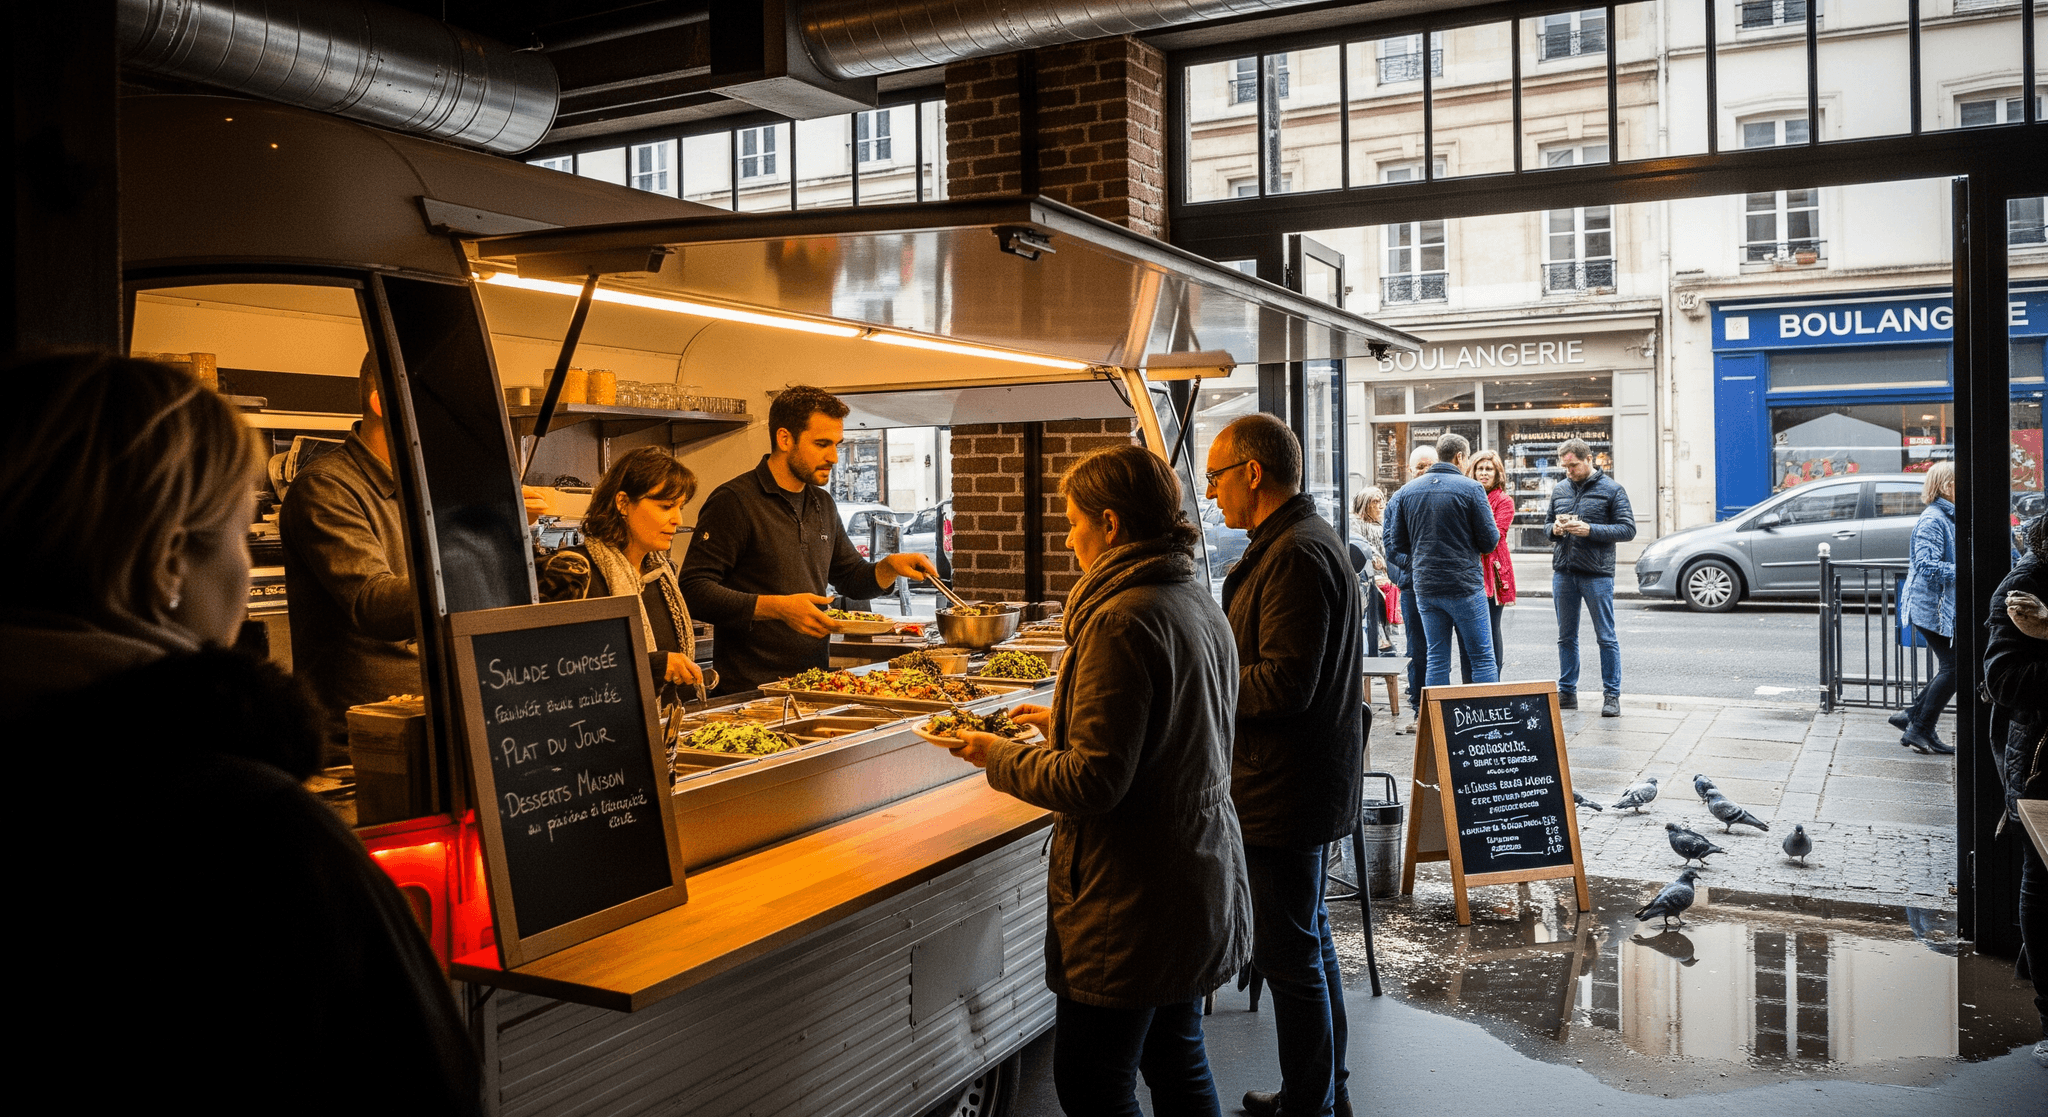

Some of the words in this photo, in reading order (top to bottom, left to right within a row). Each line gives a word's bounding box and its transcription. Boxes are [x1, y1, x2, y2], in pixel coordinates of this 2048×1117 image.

[1779, 301, 2029, 338] BOULANGE
[489, 658, 550, 690] SALADE
[557, 643, 618, 677] COMPOSÉE
[501, 737, 539, 769] PLAT
[547, 738, 567, 755] DU
[569, 719, 616, 749] JOUR
[505, 785, 572, 818] DESSERTS
[577, 768, 625, 796] MAISON
